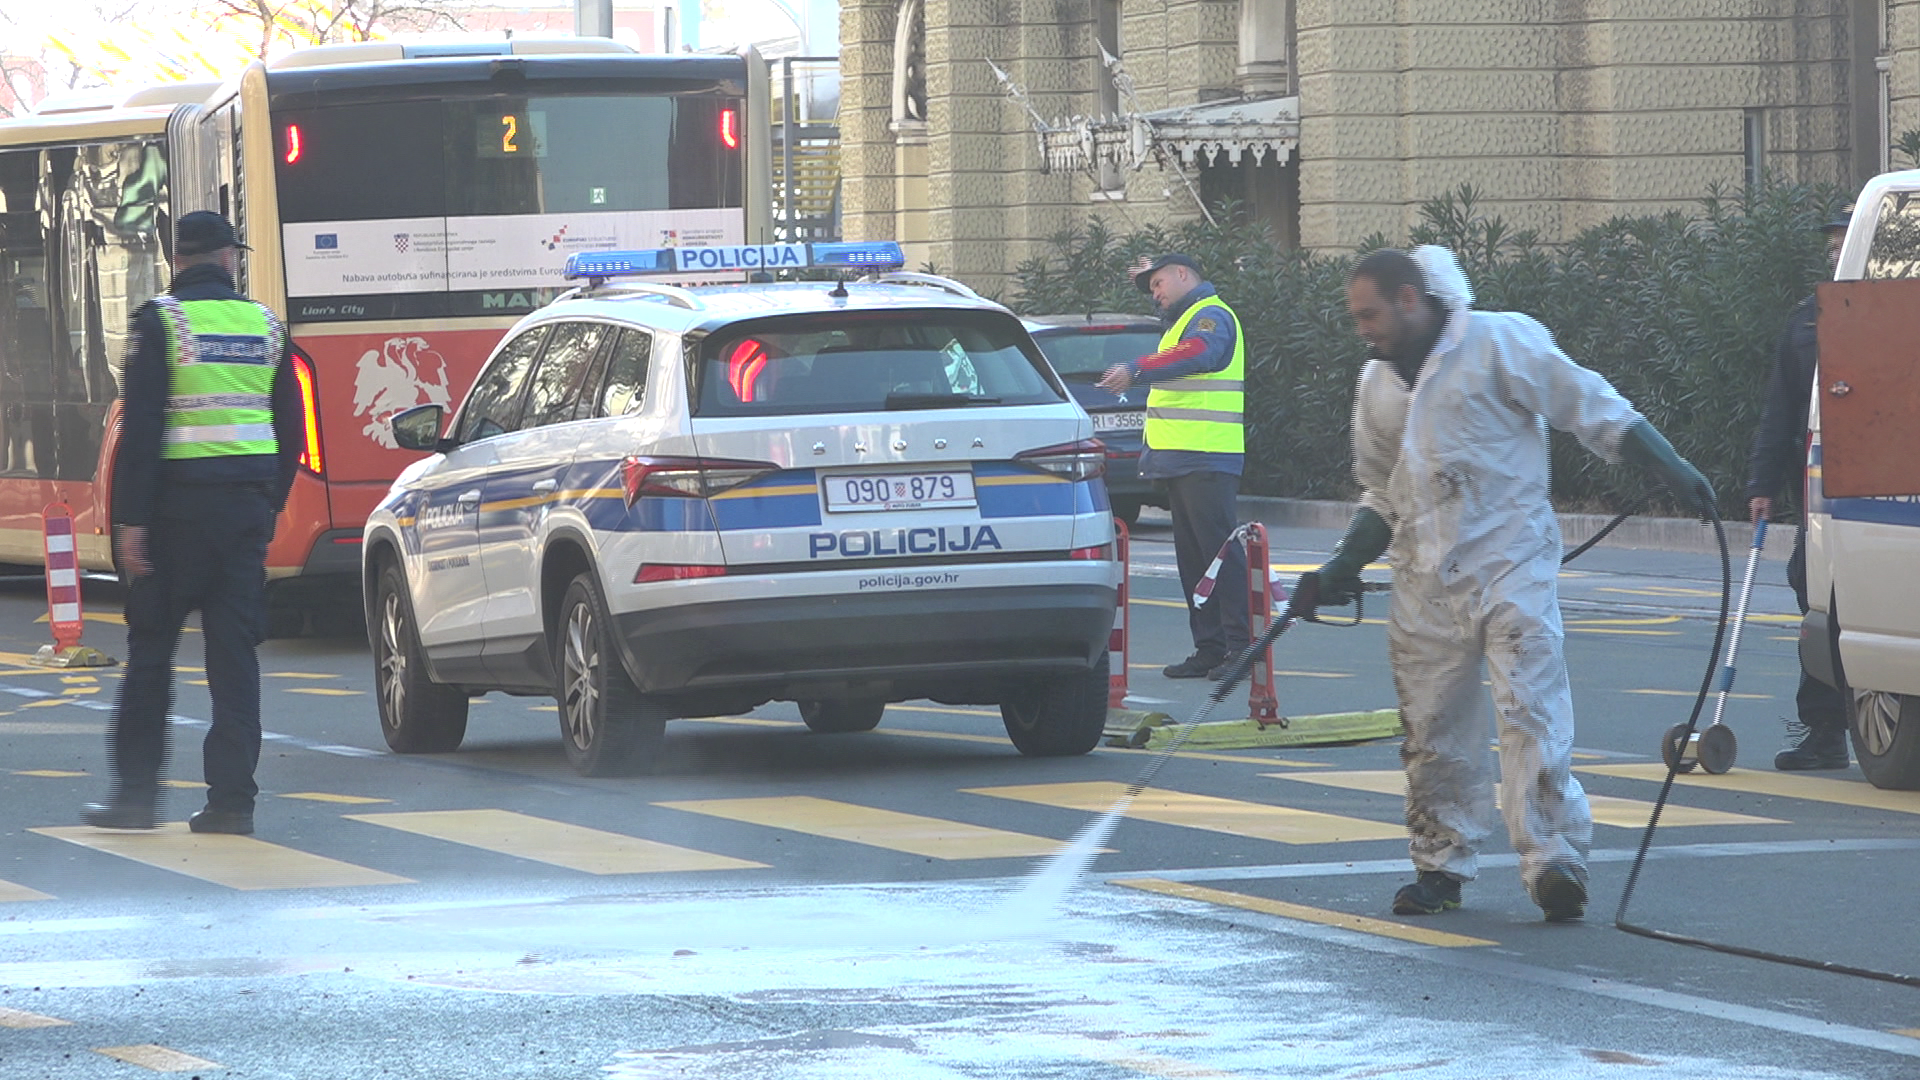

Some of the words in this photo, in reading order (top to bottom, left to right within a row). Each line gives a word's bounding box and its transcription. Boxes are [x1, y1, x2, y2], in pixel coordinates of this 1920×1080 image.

[502, 115, 517, 152] 2
[682, 247, 799, 268] POLICIJA
[342, 274, 375, 282] Nabava
[377, 272, 418, 281] autobusa
[420, 270, 478, 280] sufinancirana
[479, 269, 488, 280] je
[490, 268, 537, 277] sredstvima
[302, 306, 336, 315] Lion's
[341, 305, 364, 315] City
[197, 340, 267, 358] POLICIJA
[1092, 415, 1105, 428] RI
[1115, 413, 1144, 427] 3566
[846, 479, 890, 503] 090
[911, 476, 955, 500] 879
[427, 502, 464, 529] POLICIJA
[809, 525, 1003, 559] POLICIJA
[859, 573, 960, 590] policija.gov.hr
